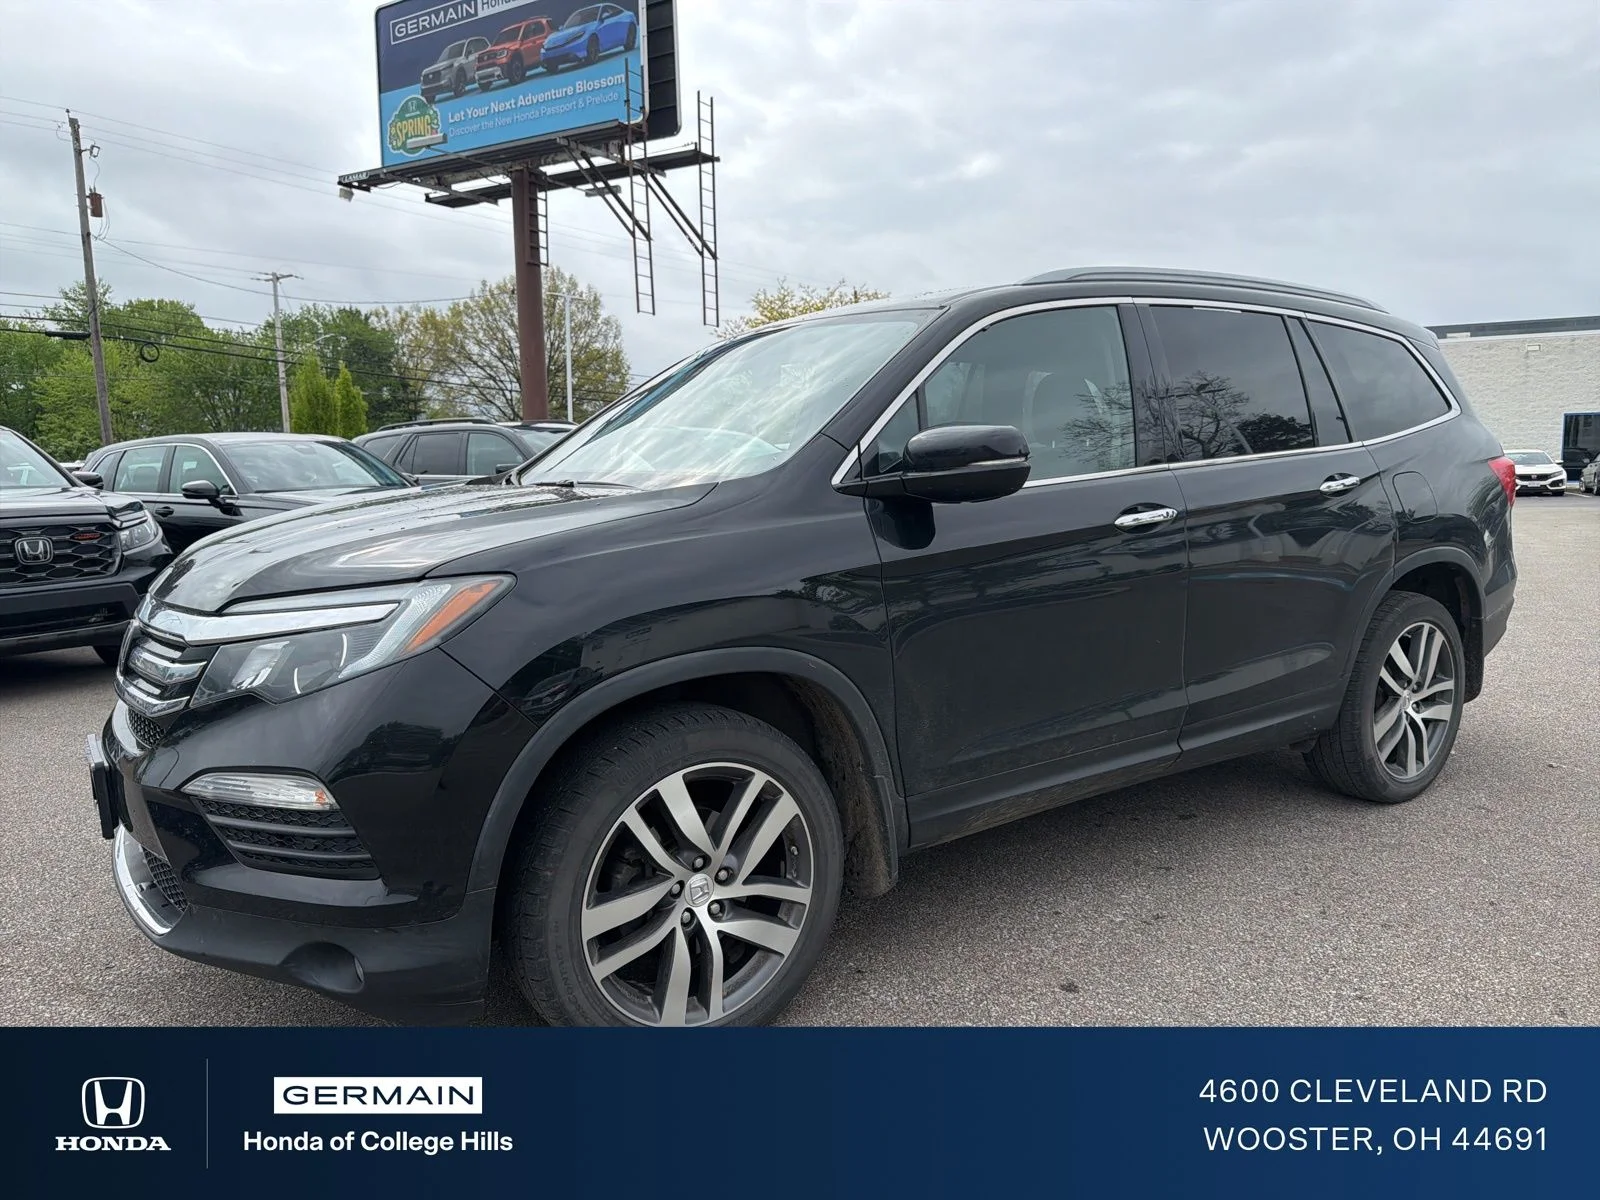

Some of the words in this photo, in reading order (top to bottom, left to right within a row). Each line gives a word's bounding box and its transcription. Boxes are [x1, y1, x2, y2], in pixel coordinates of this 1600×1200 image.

[394, 2, 475, 38] GERMAIN
[448, 111, 465, 123] Let
[466, 105, 489, 119] Your
[491, 100, 516, 114] Next
[517, 87, 574, 108] Adventure
[575, 73, 626, 93] Blossom
[449, 123, 481, 137] Discover
[481, 120, 494, 130] the
[495, 115, 512, 127] New
[513, 110, 540, 124] Honda
[541, 102, 578, 117] Passport
[578, 98, 585, 108] &
[586, 91, 619, 107] Prelude
[395, 115, 432, 147] SPRING
